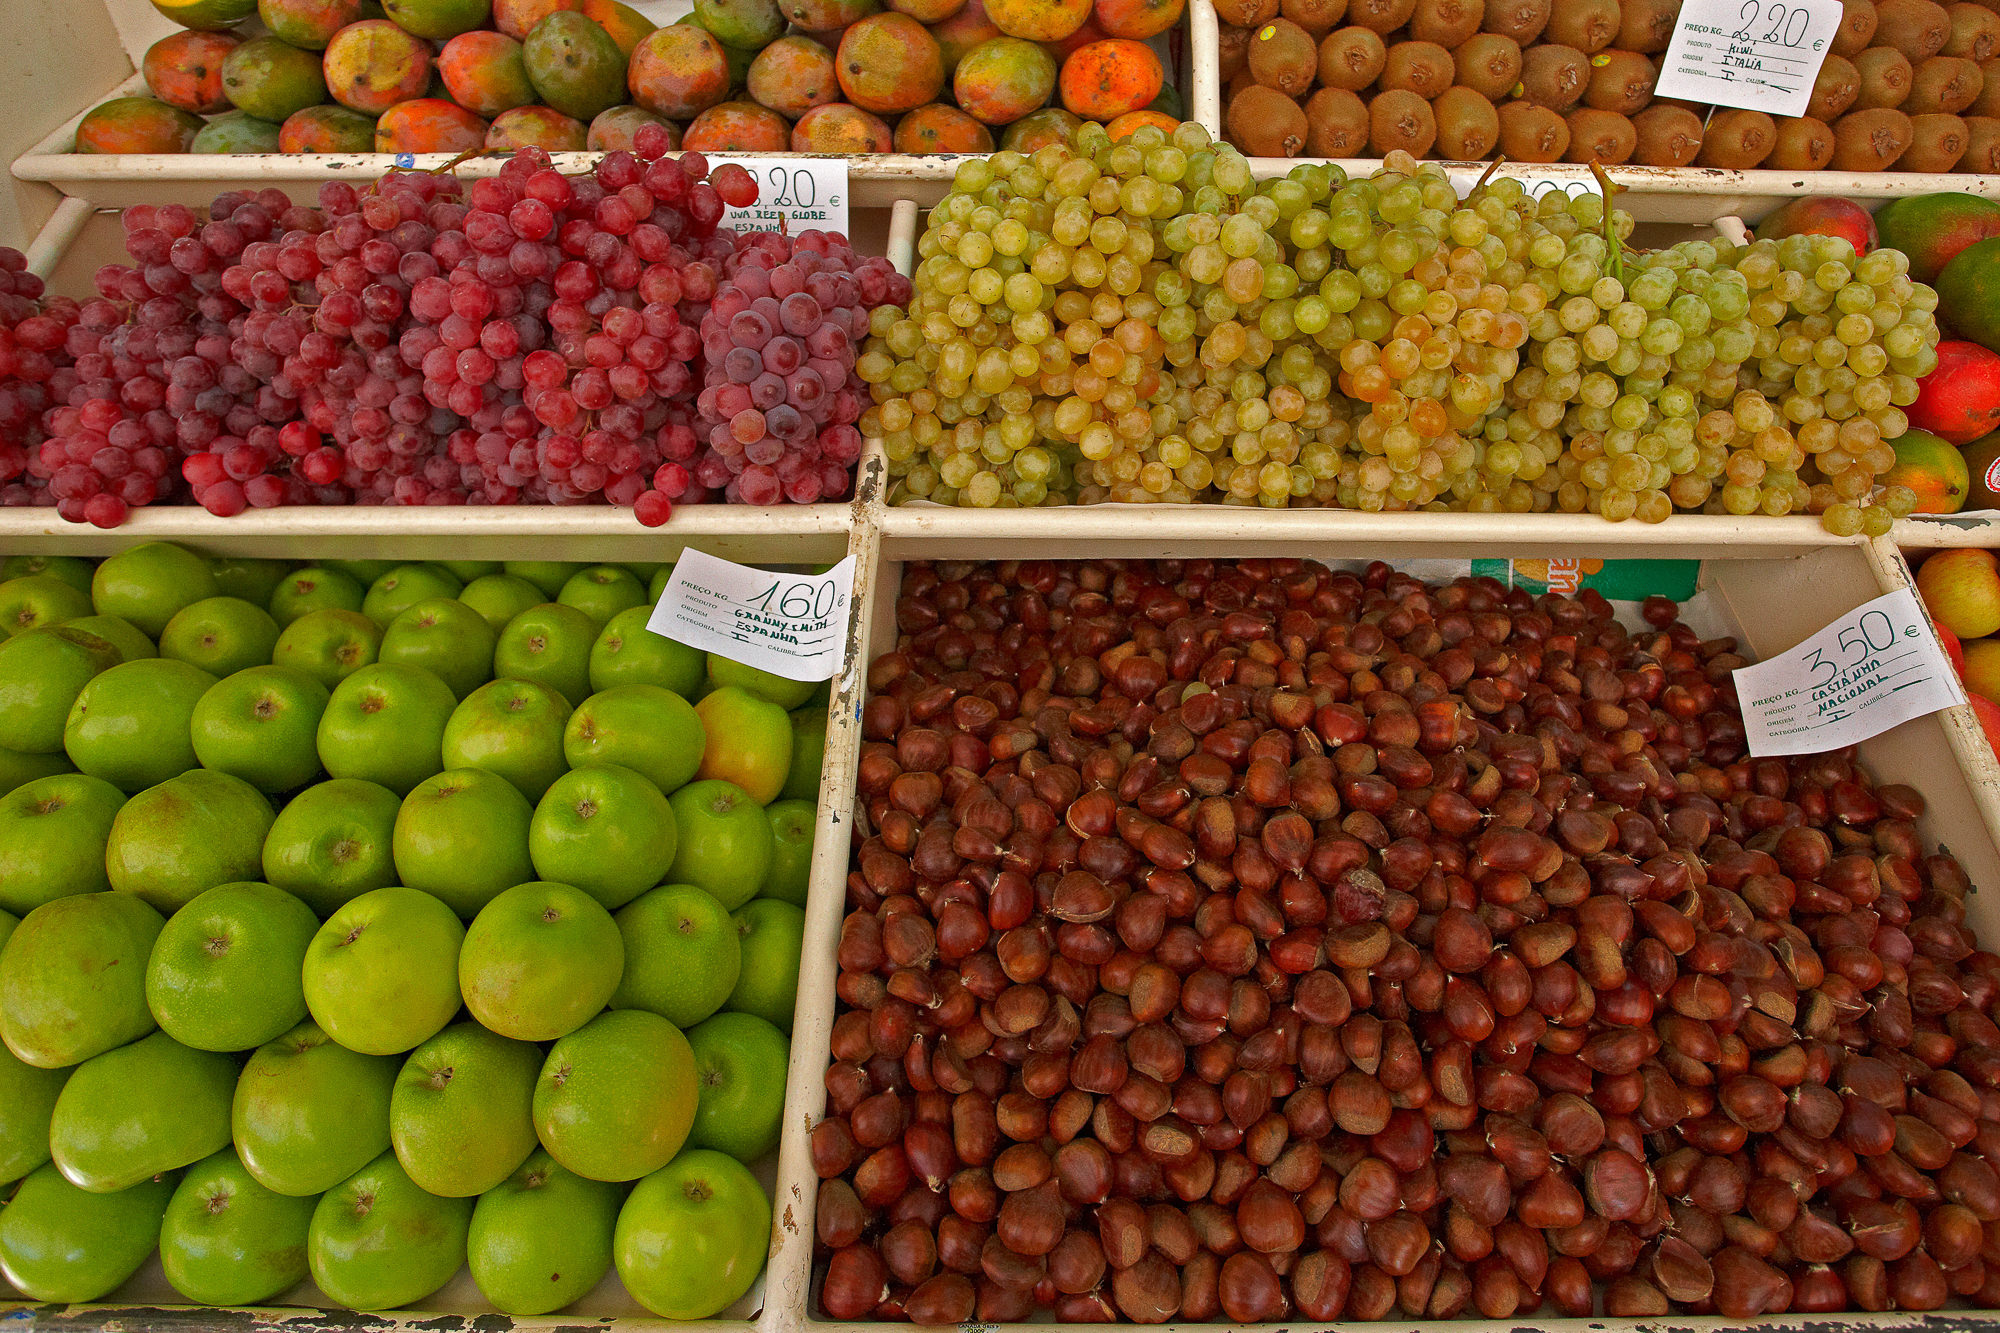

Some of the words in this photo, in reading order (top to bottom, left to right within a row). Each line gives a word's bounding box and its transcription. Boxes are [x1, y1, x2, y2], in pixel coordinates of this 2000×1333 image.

[1684, 23, 1709, 34] PREÇO
[1710, 27, 1722, 36] KG
[1813, 39, 1824, 51] €
[1686, 40, 1712, 49] PRODUTO
[1677, 67, 1707, 77] CATEGORIA
[1682, 53, 1704, 62] ORIGEM
[1721, 55, 1762, 70] ITALIA
[730, 211, 751, 219] UVA
[792, 210, 826, 219] GLOBE
[830, 195, 840, 207] €
[681, 580, 711, 595] PREÇO
[715, 592, 728, 601] KG
[838, 594, 845, 607] €
[685, 594, 718, 609] PRODUTO
[676, 613, 715, 632] CATEGORIA
[767, 644, 797, 656] CALIBRE
[680, 604, 708, 618] ORIGEM
[735, 621, 799, 645] ESPANHA
[1752, 694, 1783, 707] PREÇO
[1784, 688, 1799, 697] KG
[1904, 625, 1920, 638] €
[1764, 703, 1797, 717] PRODUTO
[1812, 659, 1881, 702] CASTANHA
[1766, 716, 1795, 727] ORIGEM
[1818, 674, 1889, 716] NACIONAL
[1769, 725, 1810, 737] CATEGORIA
[1858, 692, 1884, 710] CALIBRE
